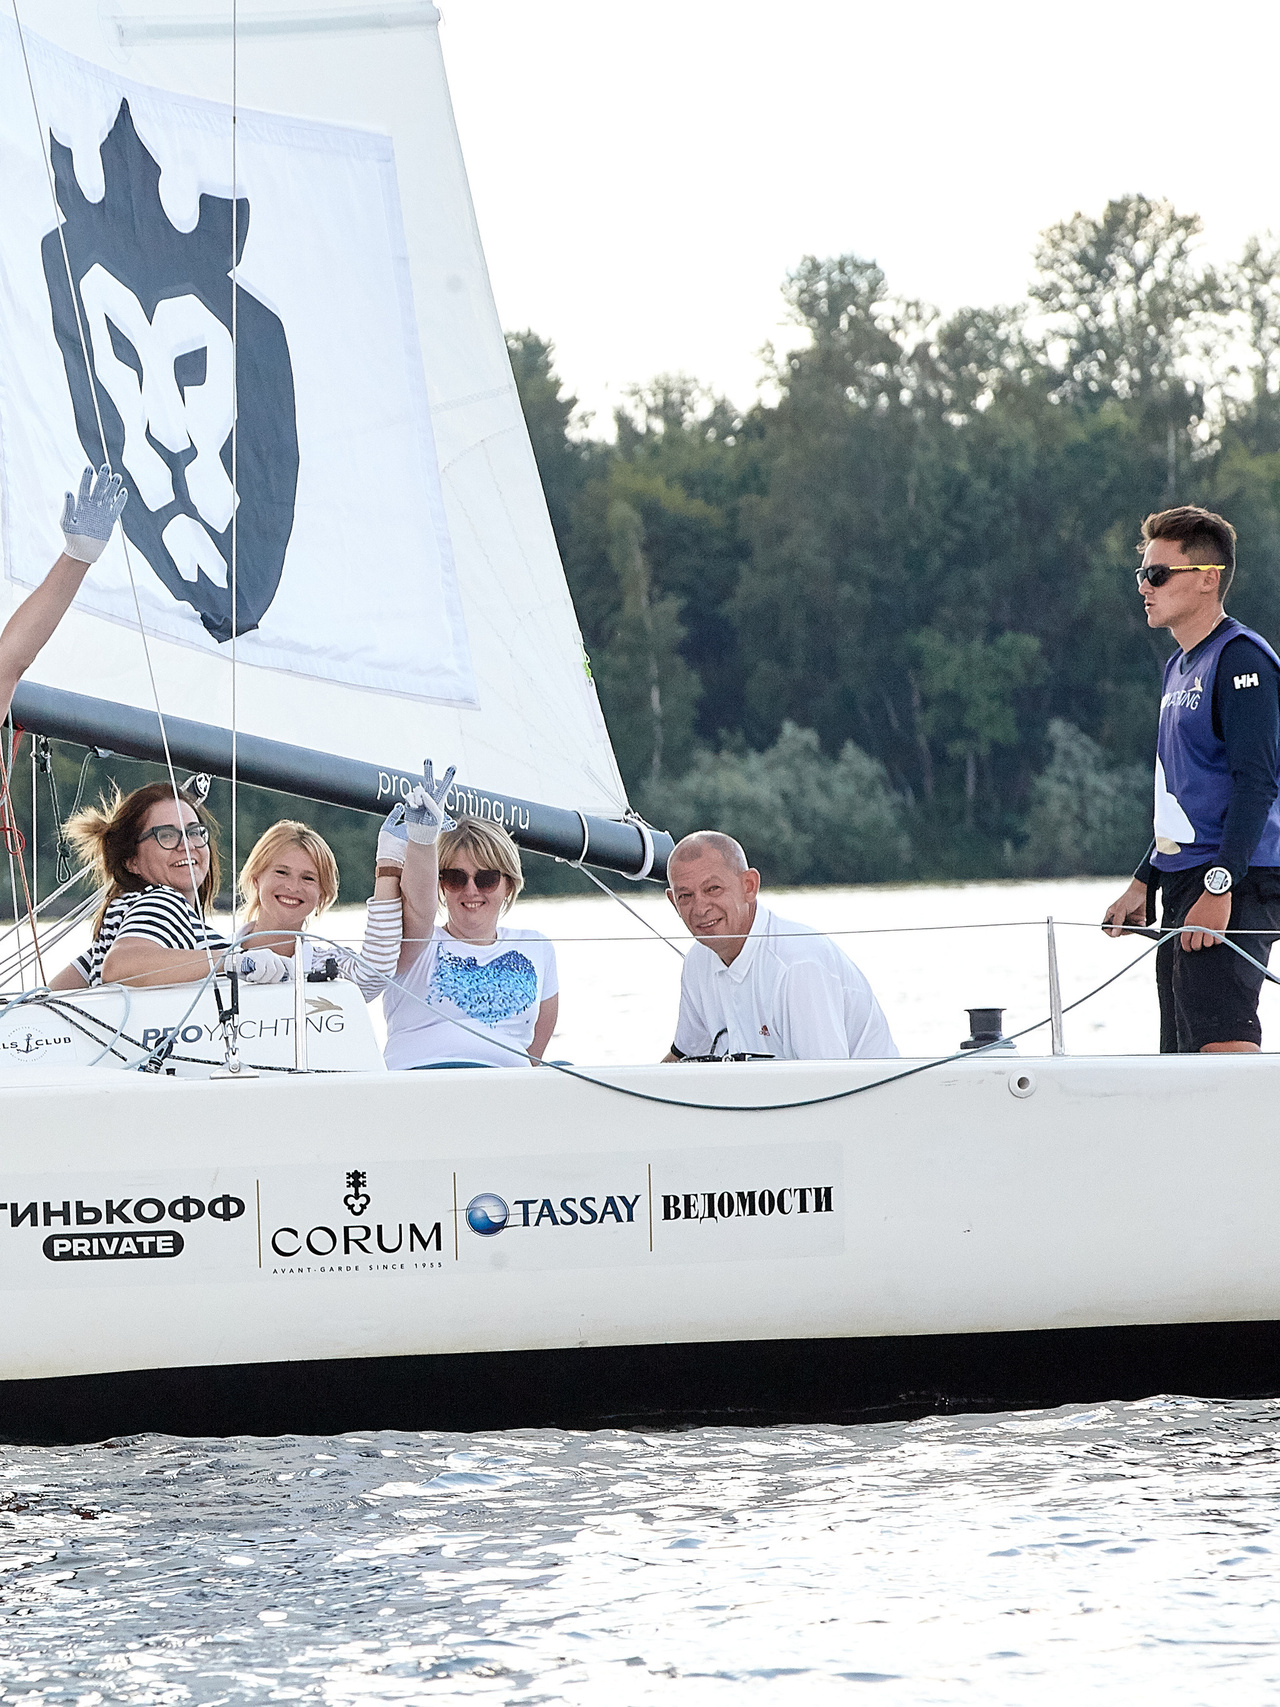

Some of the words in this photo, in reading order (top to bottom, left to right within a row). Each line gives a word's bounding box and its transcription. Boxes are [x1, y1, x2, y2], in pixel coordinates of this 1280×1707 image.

[377, 770, 531, 831] prochting.ru
[513, 1194, 643, 1228] TASSAY
[661, 1185, 835, 1225] ВЕДОМОСТИ
[52, 1235, 175, 1257] PRIVATE
[271, 1221, 443, 1258] CORUM
[272, 1265, 360, 1275] AVANT-GARDE
[368, 1263, 405, 1271] SINCE
[414, 1261, 443, 1269] 1955
